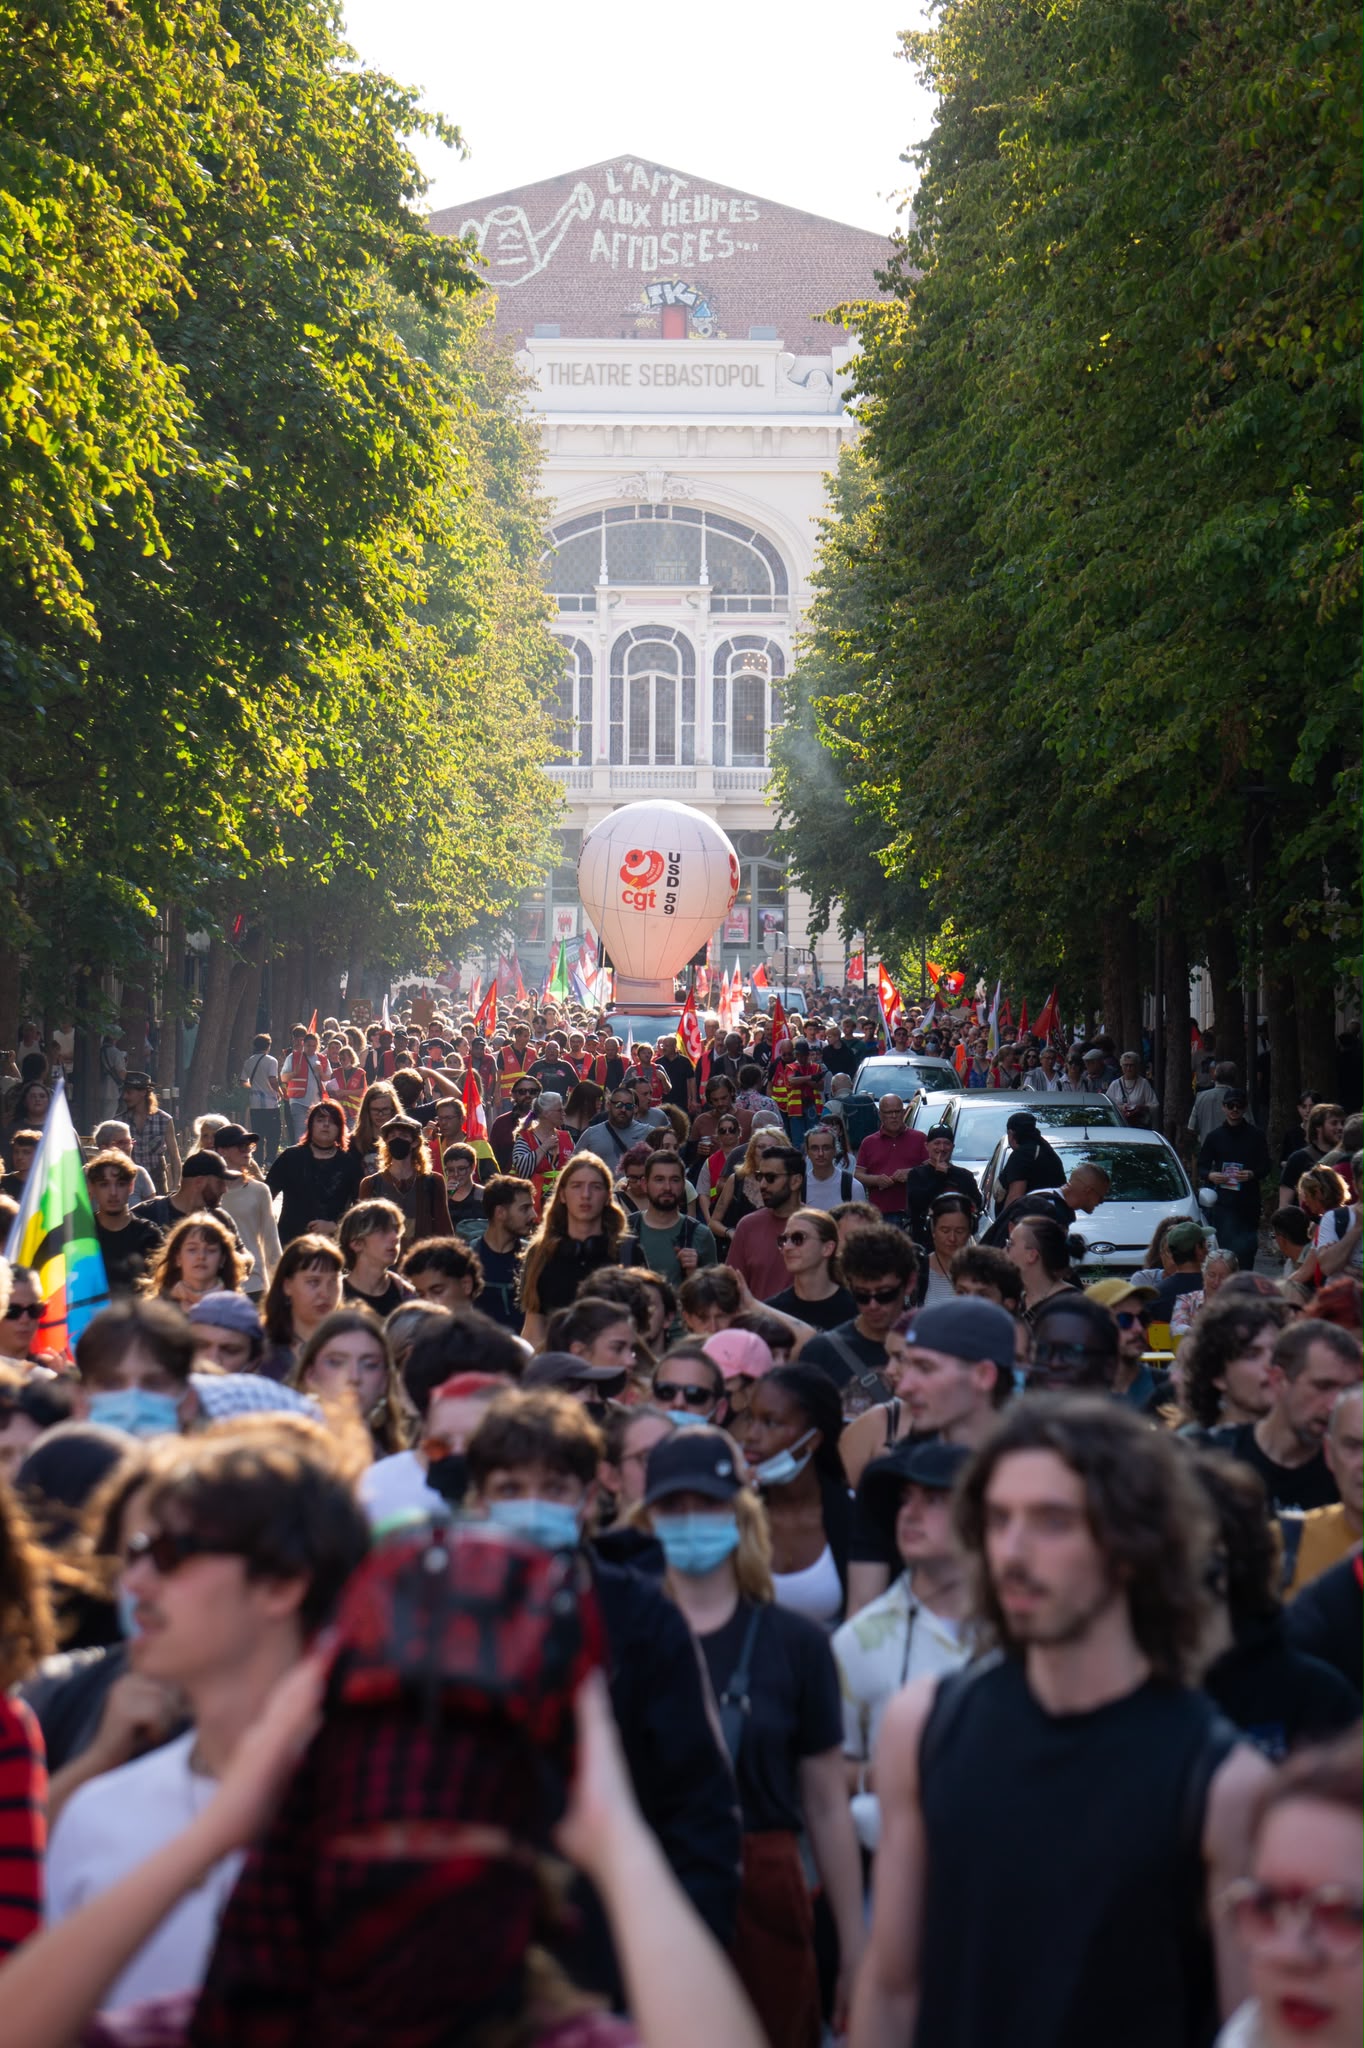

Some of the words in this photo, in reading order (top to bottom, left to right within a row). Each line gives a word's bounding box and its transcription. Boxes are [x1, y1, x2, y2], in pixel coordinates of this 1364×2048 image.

[599, 197, 651, 229] AUX
[549, 364, 632, 385] THEATRE
[639, 365, 764, 387] SEBASTOPOL
[667, 852, 681, 888] USD
[622, 890, 656, 911] cgt
[664, 893, 676, 915] 59
